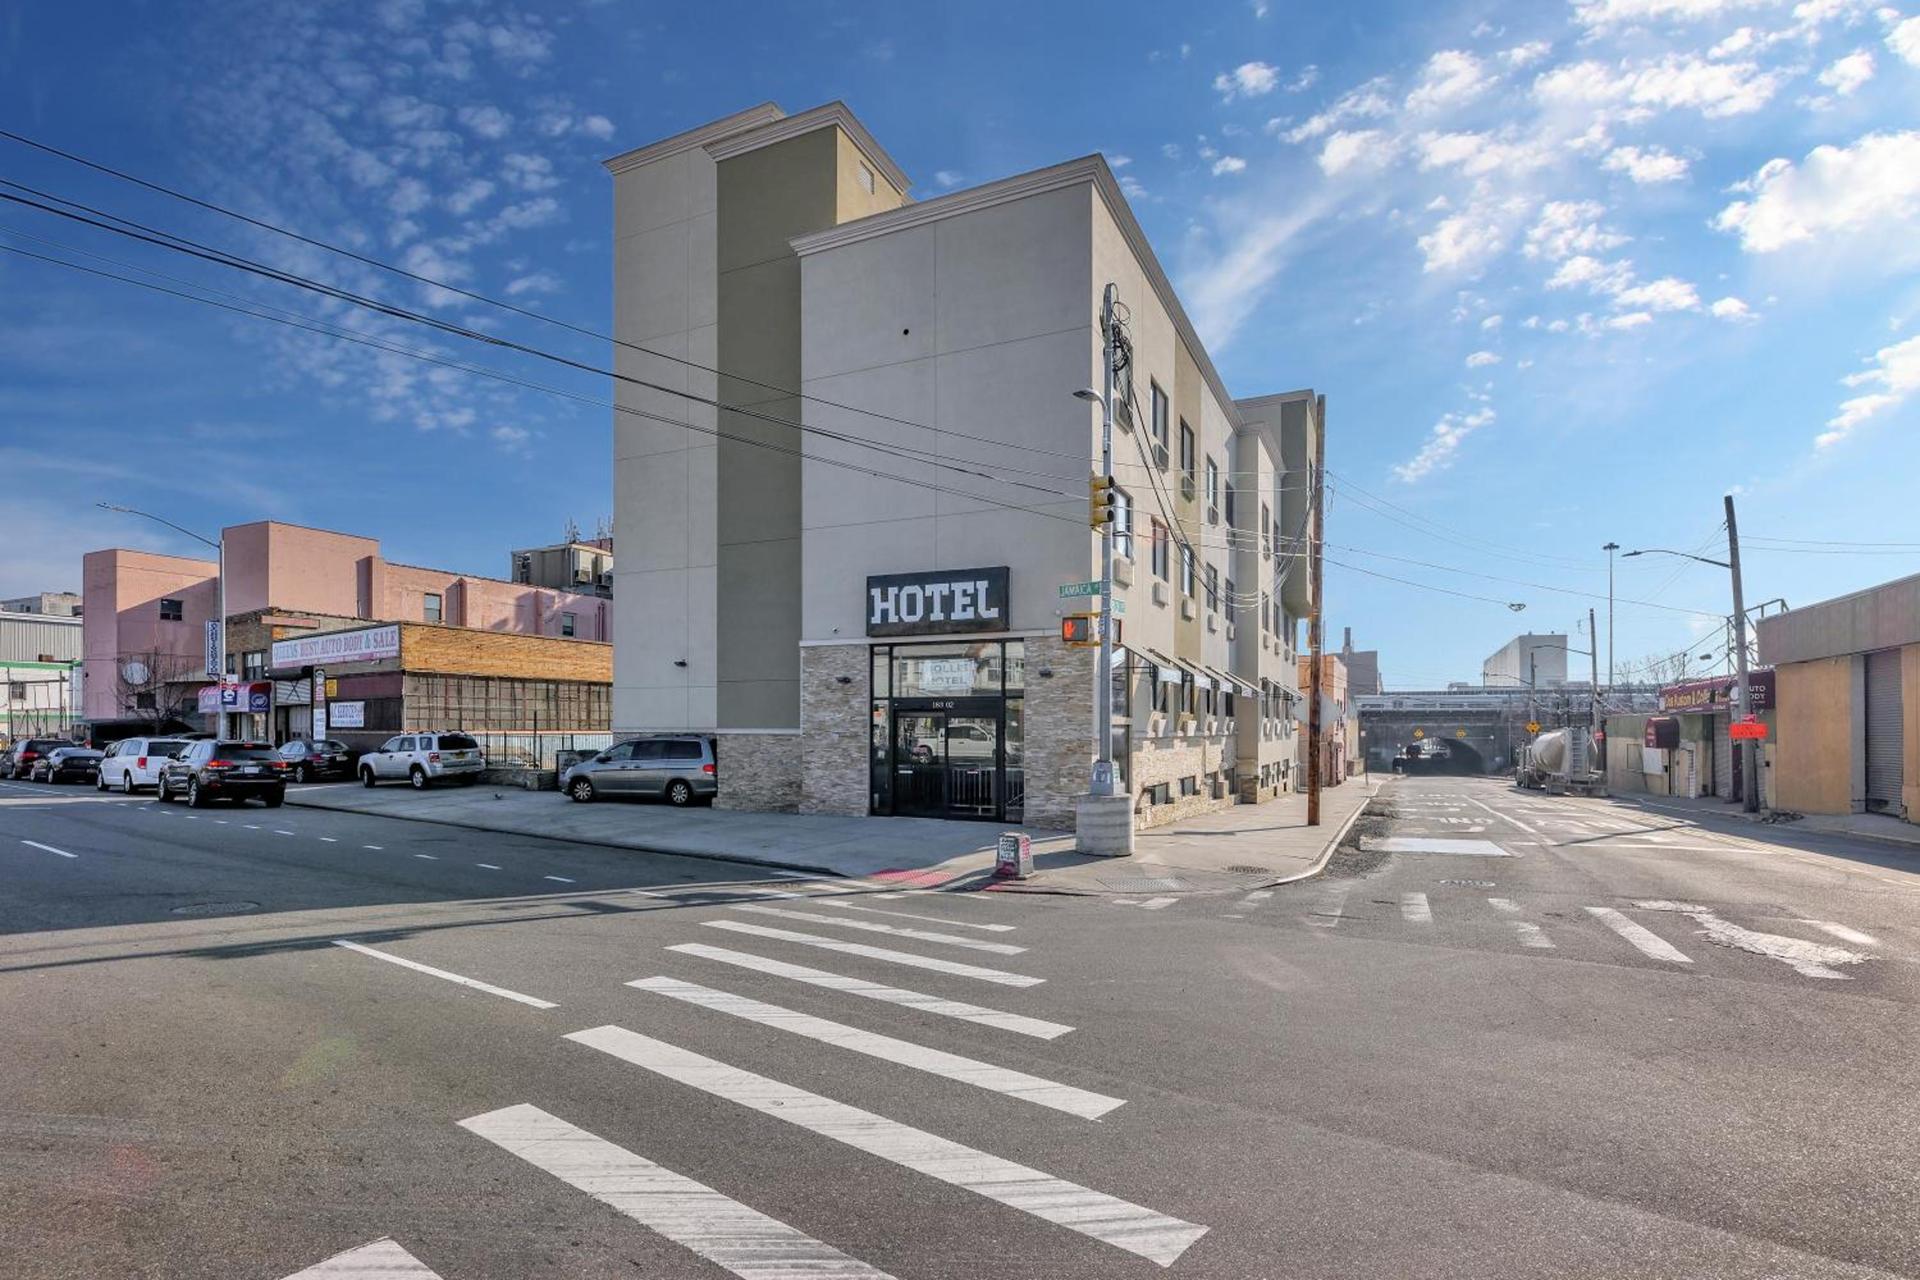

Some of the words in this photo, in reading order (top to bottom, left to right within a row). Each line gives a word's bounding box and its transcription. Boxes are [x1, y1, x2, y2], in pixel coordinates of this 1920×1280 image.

[870, 580, 999, 624] HOTEL
[1061, 583, 1092, 597] JAMAICA
[320, 638, 341, 655] AUTO
[344, 635, 362, 652] BODY
[364, 631, 371, 649] &
[373, 629, 397, 649] SALE
